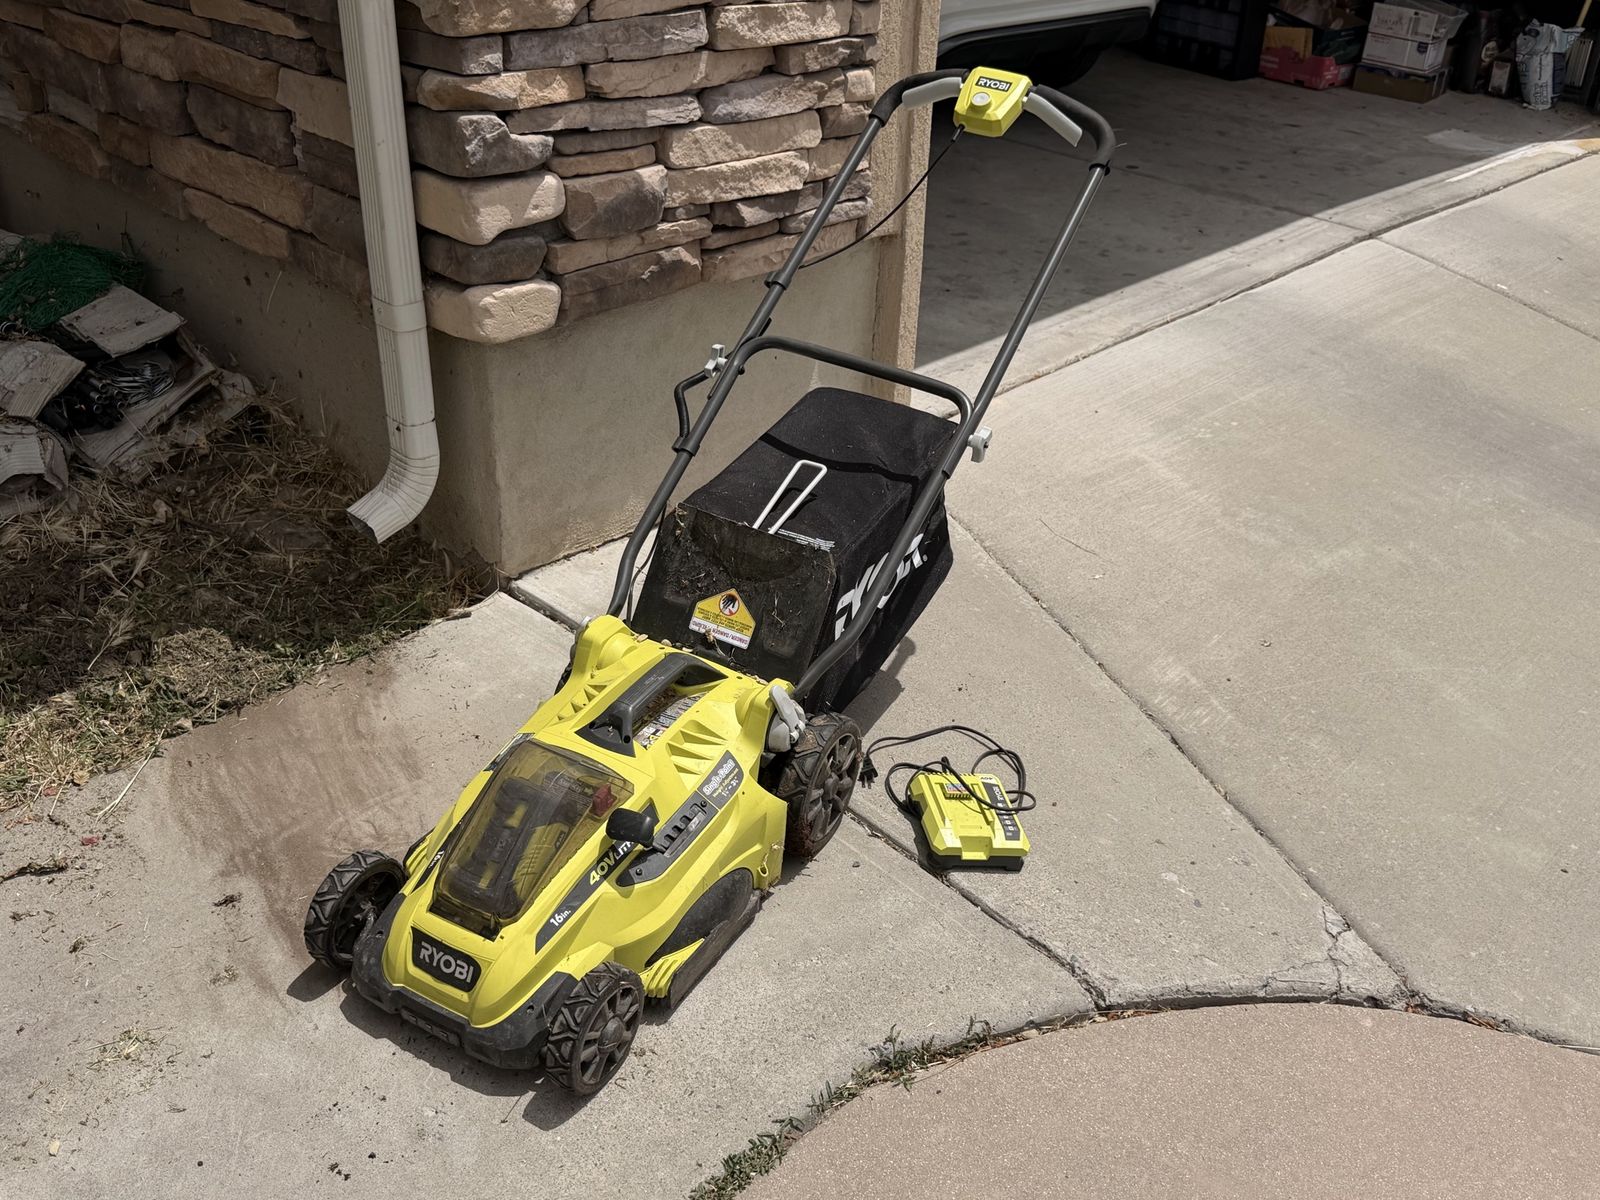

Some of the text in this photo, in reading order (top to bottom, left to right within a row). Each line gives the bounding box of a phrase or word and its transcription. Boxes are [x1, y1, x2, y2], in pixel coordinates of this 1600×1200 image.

[978, 77, 1010, 91] RYOBI
[589, 849, 615, 886] 40V
[549, 910, 571, 927] 16in.
[419, 940, 474, 983] RYOBI
